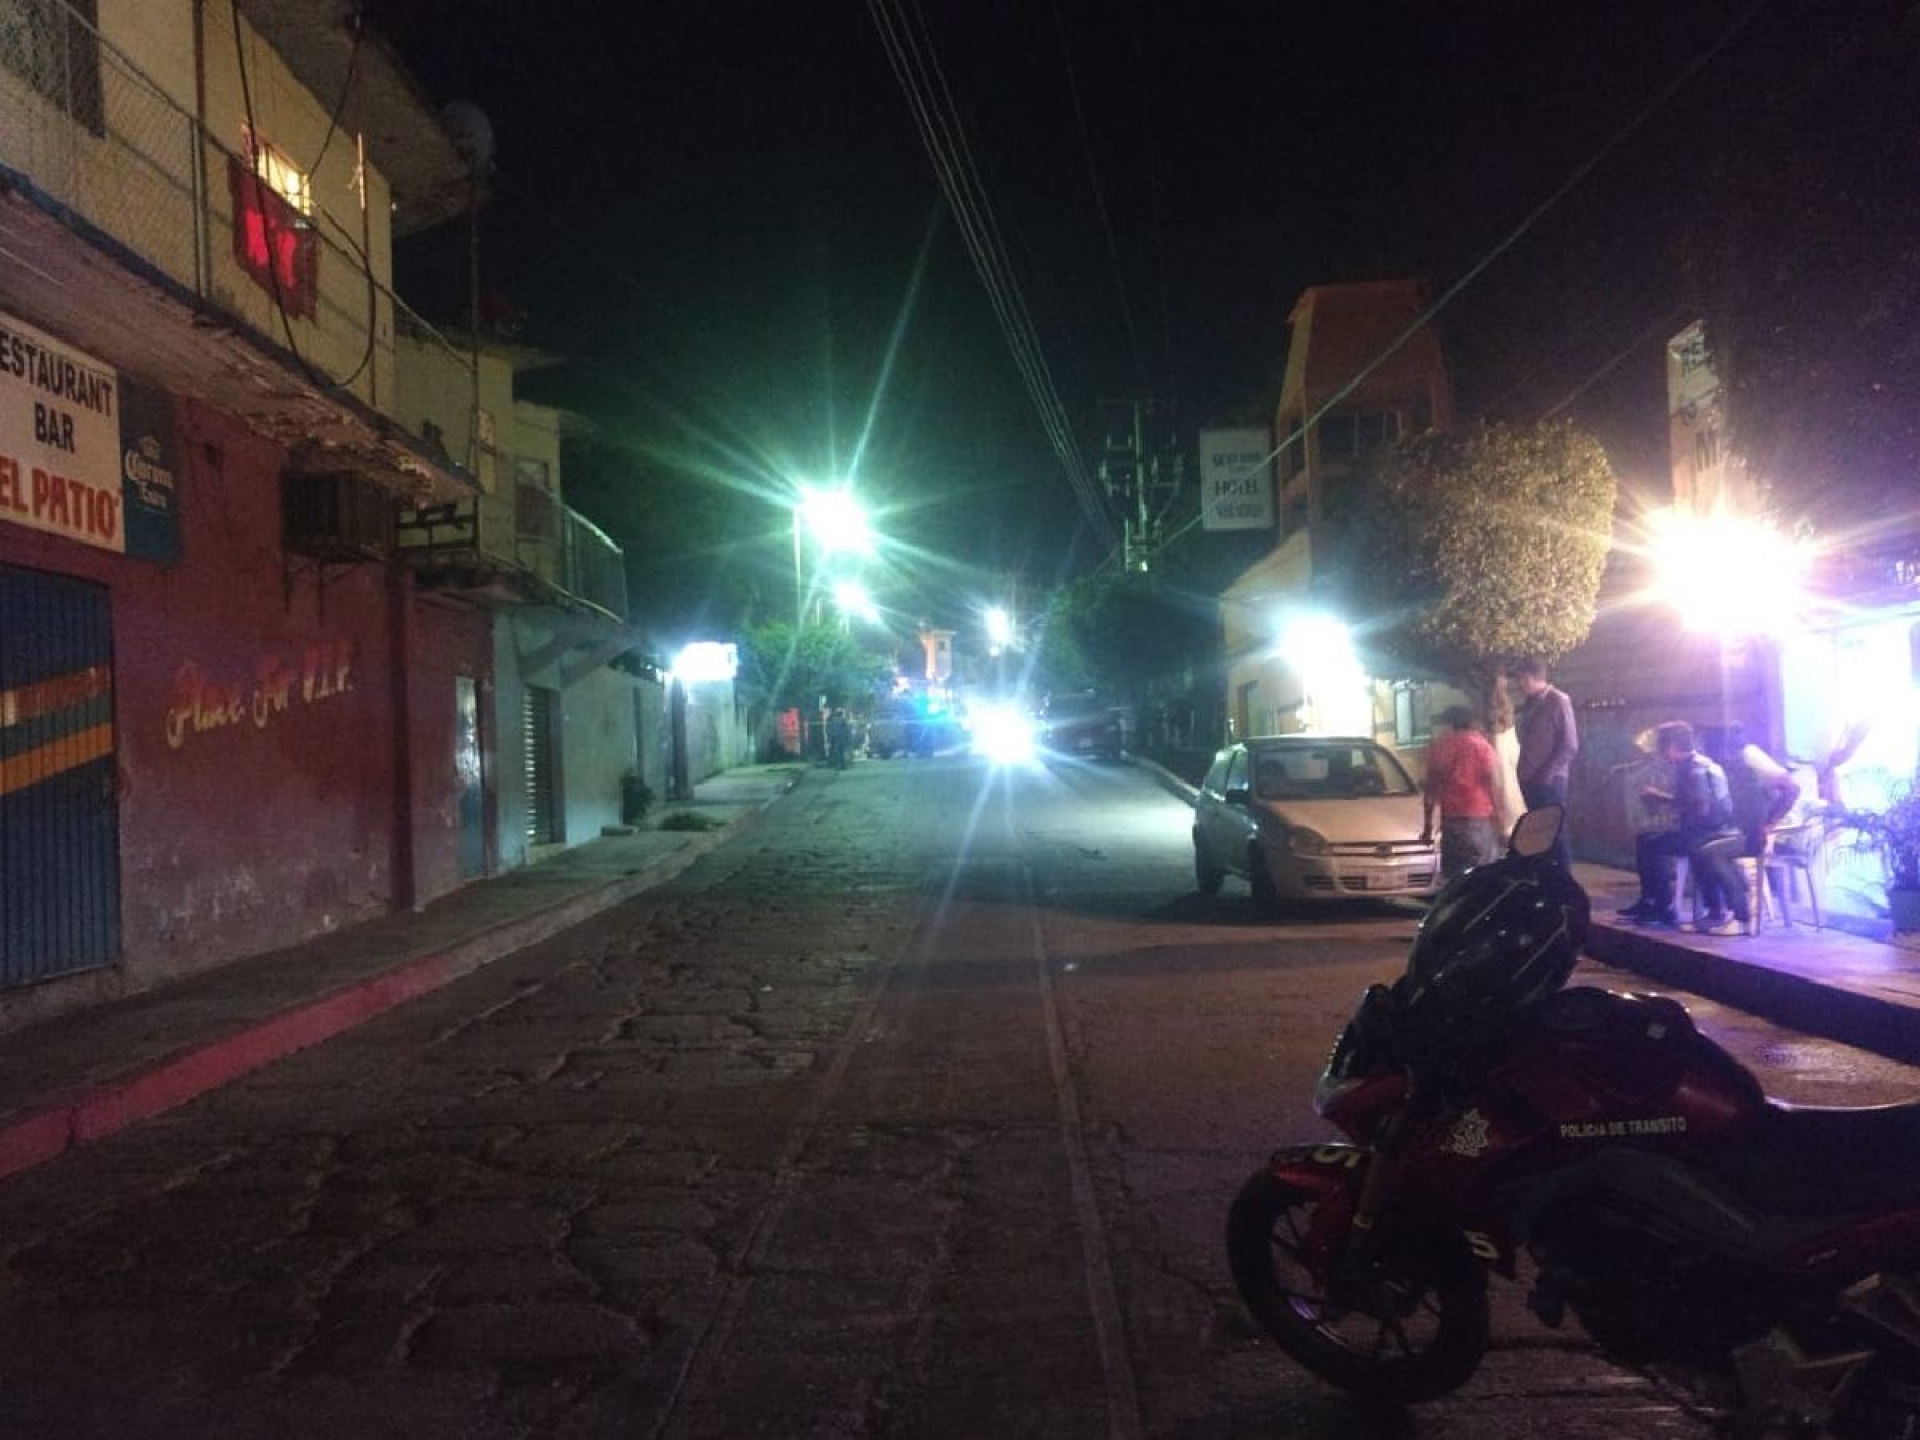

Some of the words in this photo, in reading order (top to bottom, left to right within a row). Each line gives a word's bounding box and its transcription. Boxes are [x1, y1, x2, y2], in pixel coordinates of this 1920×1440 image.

[34, 402, 75, 453] BAR
[0, 455, 28, 513] EL
[1560, 1123, 1606, 1137] POLICIA
[1608, 1121, 1627, 1136] DE
[1628, 1116, 1687, 1134] TRANSITO
